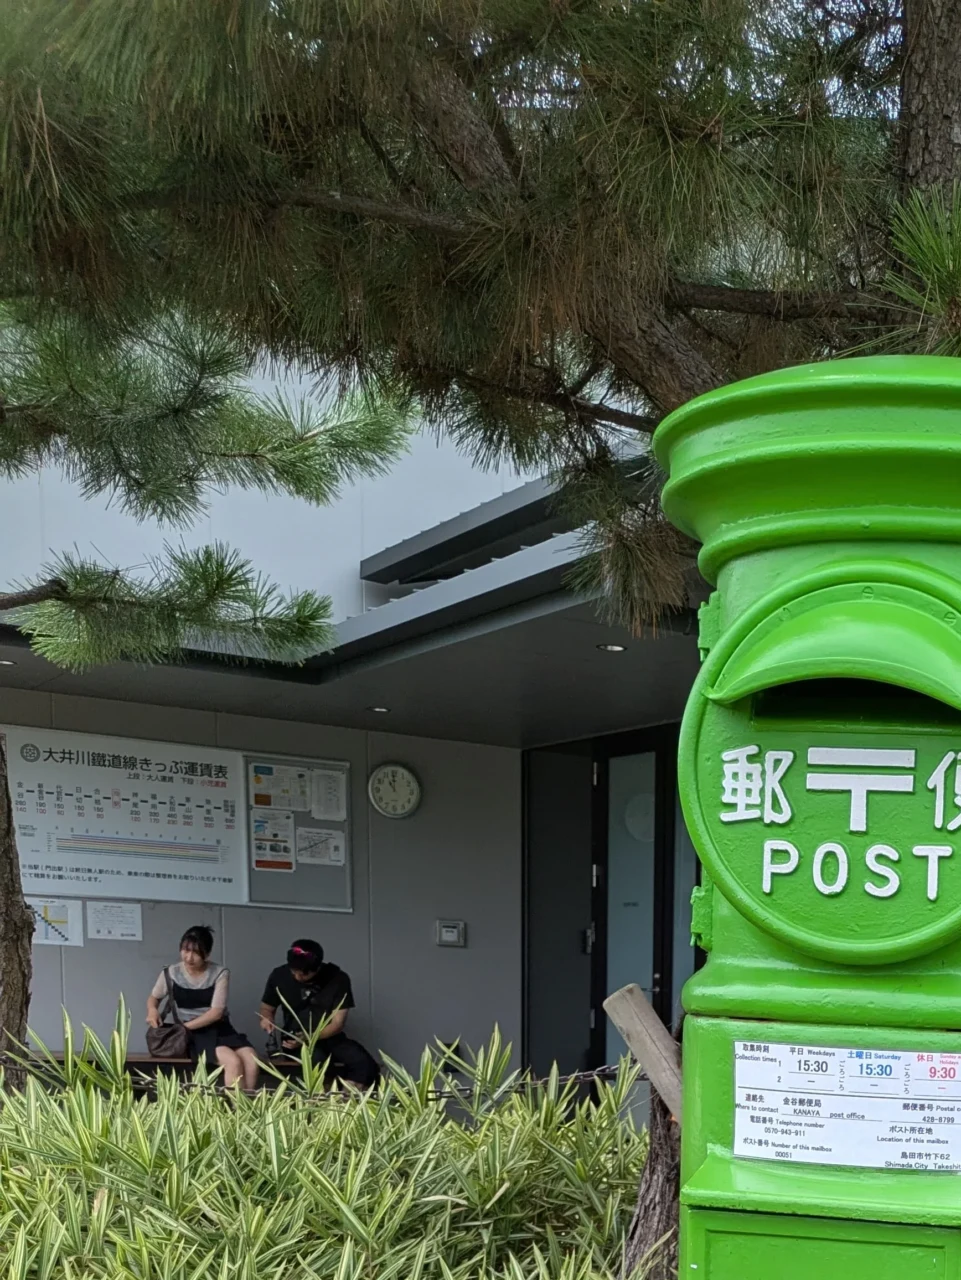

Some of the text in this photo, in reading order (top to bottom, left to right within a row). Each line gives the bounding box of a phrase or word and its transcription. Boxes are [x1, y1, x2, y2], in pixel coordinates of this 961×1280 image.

[42, 748, 229, 780] 大井川鐵道線きっぷ運賃表
[762, 839, 953, 901] POST
[789, 1047, 835, 1057] 平日 Weekdays
[847, 1051, 901, 1061] 土曜日 Saturday
[735, 1053, 761, 1062] Collection
[917, 1053, 934, 1063] 休日
[797, 1058, 828, 1073] 15:30
[858, 1063, 893, 1077] 15:30
[928, 1066, 957, 1079] 9:30
[745, 1093, 765, 1103] 連絡先
[783, 1096, 822, 1108] 金谷郵便局
[793, 1108, 820, 1117] KANAYA
[902, 1103, 934, 1112] 郵便番号
[936, 1104, 956, 1112] Postal
[749, 1115, 825, 1129] 電話番号 Telephone number
[922, 1116, 955, 1124] 428-8799
[764, 1126, 805, 1137] 0570-943-911
[889, 1125, 934, 1135] ポスト所在地
[742, 1136, 770, 1147] ポスト番号
[771, 1141, 791, 1149] Number
[926, 1137, 949, 1145] mailbox
[775, 1151, 792, 1159] 00051
[900, 1151, 951, 1161] 島田市竹下62
